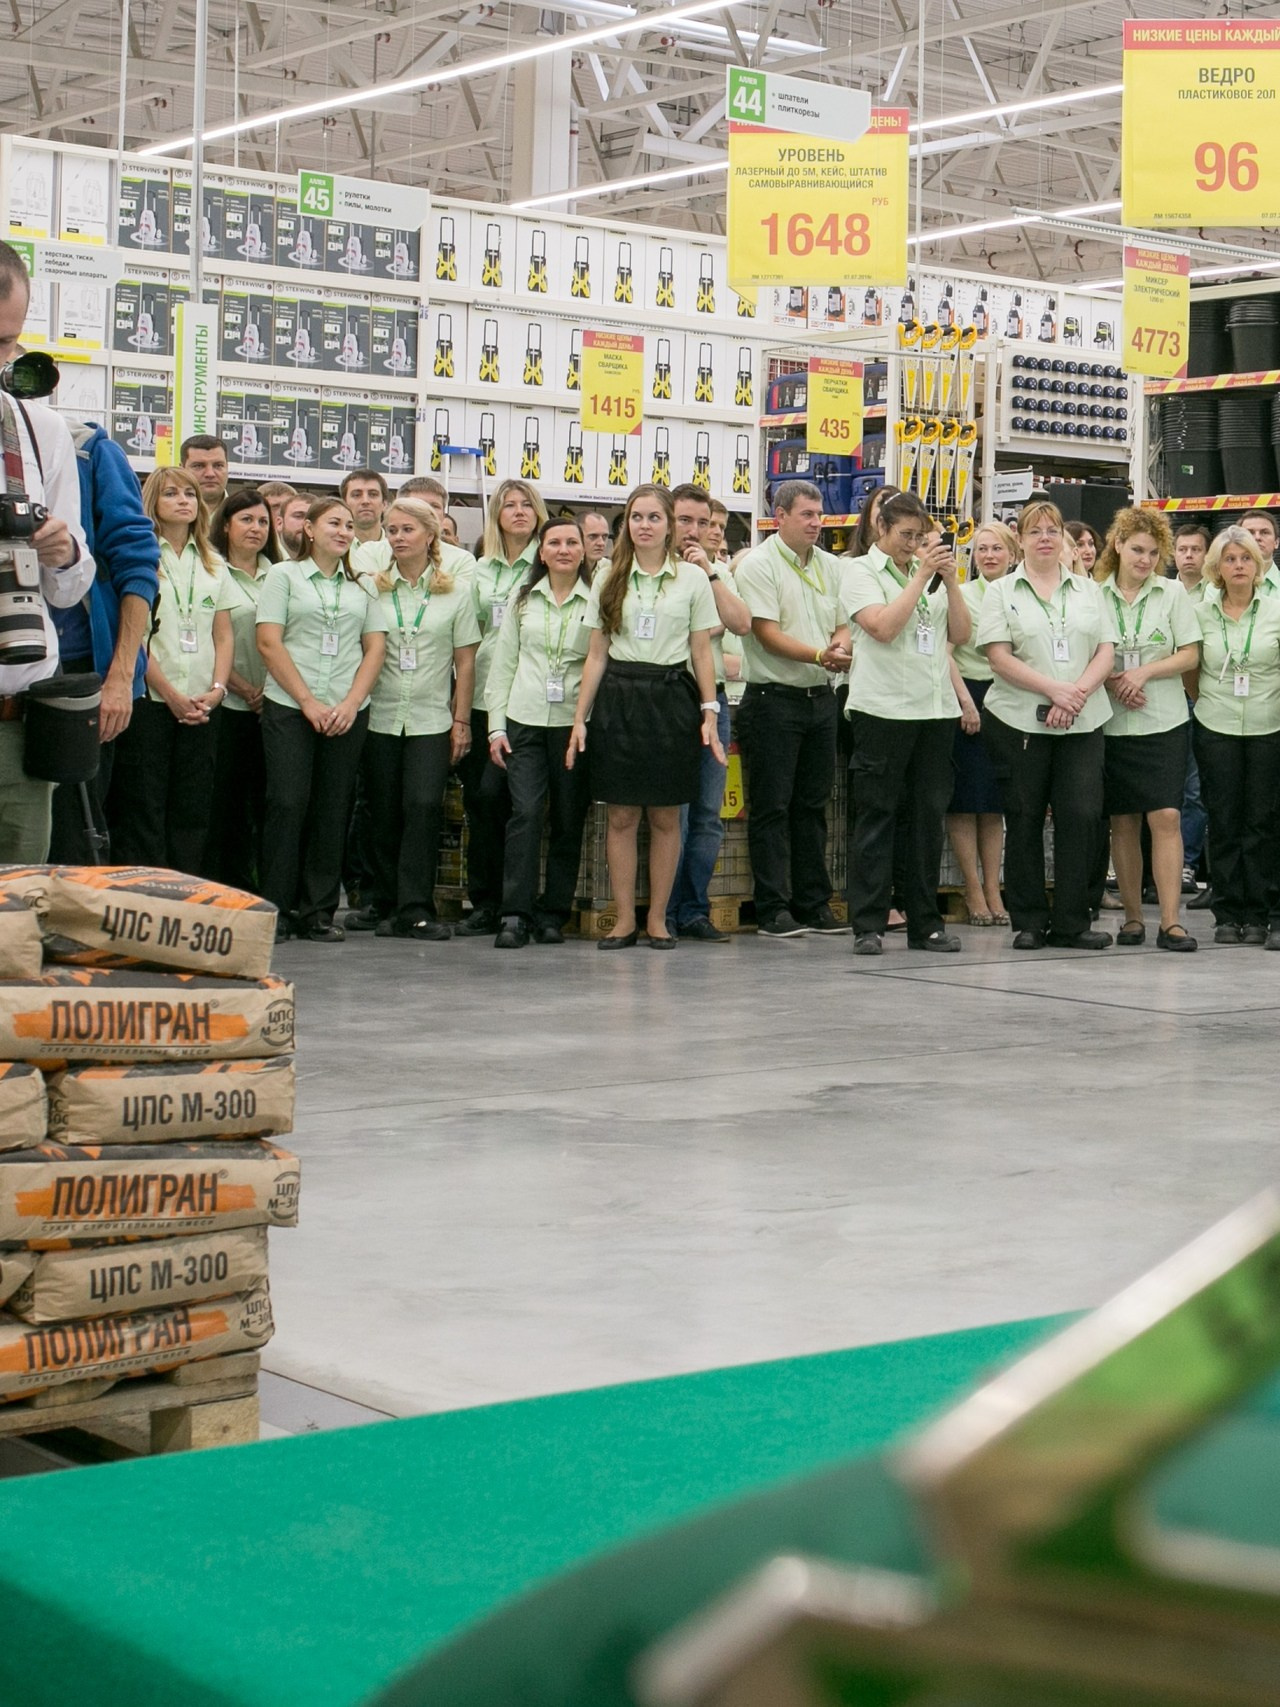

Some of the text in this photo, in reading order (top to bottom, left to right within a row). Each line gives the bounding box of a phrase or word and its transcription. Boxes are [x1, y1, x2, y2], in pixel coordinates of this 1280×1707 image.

[1133, 28, 1183, 41] НИЗКИЕ
[1185, 28, 1221, 43] ЦЕНЫ
[1198, 67, 1256, 86] ВЕДРО
[777, 91, 809, 105] шпатели
[1178, 88, 1276, 100] ПЛАСТИКОВОЕ 20Л
[732, 86, 763, 117] 44
[777, 103, 820, 119] плиткорезы
[871, 115, 902, 128] ДЕНЬ!
[778, 148, 845, 162] УРОВЕНЬ
[129, 165, 161, 176] STERWINS
[735, 165, 888, 178] ЛАЗЕРНЫЙ ДО 5М, КЕЙС, ШТАТИВ
[1194, 141, 1260, 192] 96
[236, 179, 267, 189] STERWINS
[749, 178, 874, 191] САМОВЫРАВНИВАЮЩИЙСЯ
[303, 186, 330, 211] 45
[344, 191, 371, 201] рулетки
[872, 197, 889, 206] РУБ
[344, 201, 392, 213] пилы, молотки
[760, 212, 871, 256] 1648
[20, 253, 32, 272] 6
[44, 251, 95, 262] верстаки, тиски,
[44, 259, 70, 267] лебедки
[44, 267, 108, 280] сварочные аппараты
[1145, 275, 1169, 286] МИКСЕР
[235, 280, 265, 290] STERWINS
[285, 285, 315, 295] STERWINS
[1133, 284, 1181, 298] ЭЛЕКТРИЧЕСКИЙ
[1131, 326, 1181, 358] 4773
[603, 353, 623, 361] МАСКА
[597, 361, 629, 371] СВАРЩИКА
[194, 324, 209, 434] ИНСТРУМЕНТЫ
[823, 378, 848, 387] ПЕРЧАТКИ
[822, 386, 849, 395] СВАРЩИКА
[590, 393, 636, 418] 1415
[819, 417, 850, 439] 435
[102, 905, 233, 956] ЦПС М-300
[51, 1000, 210, 1041] ПОЛИГРАН
[268, 1010, 295, 1026] ЦПС
[260, 1023, 294, 1037] М-30
[122, 1089, 257, 1131] ЦПС М-300
[52, 1173, 219, 1216] ПОЛИГРАН
[90, 1251, 228, 1303] ЦПС М-300
[245, 1298, 270, 1315] ЦПС
[24, 1306, 193, 1370] ПОЛИГРАН
